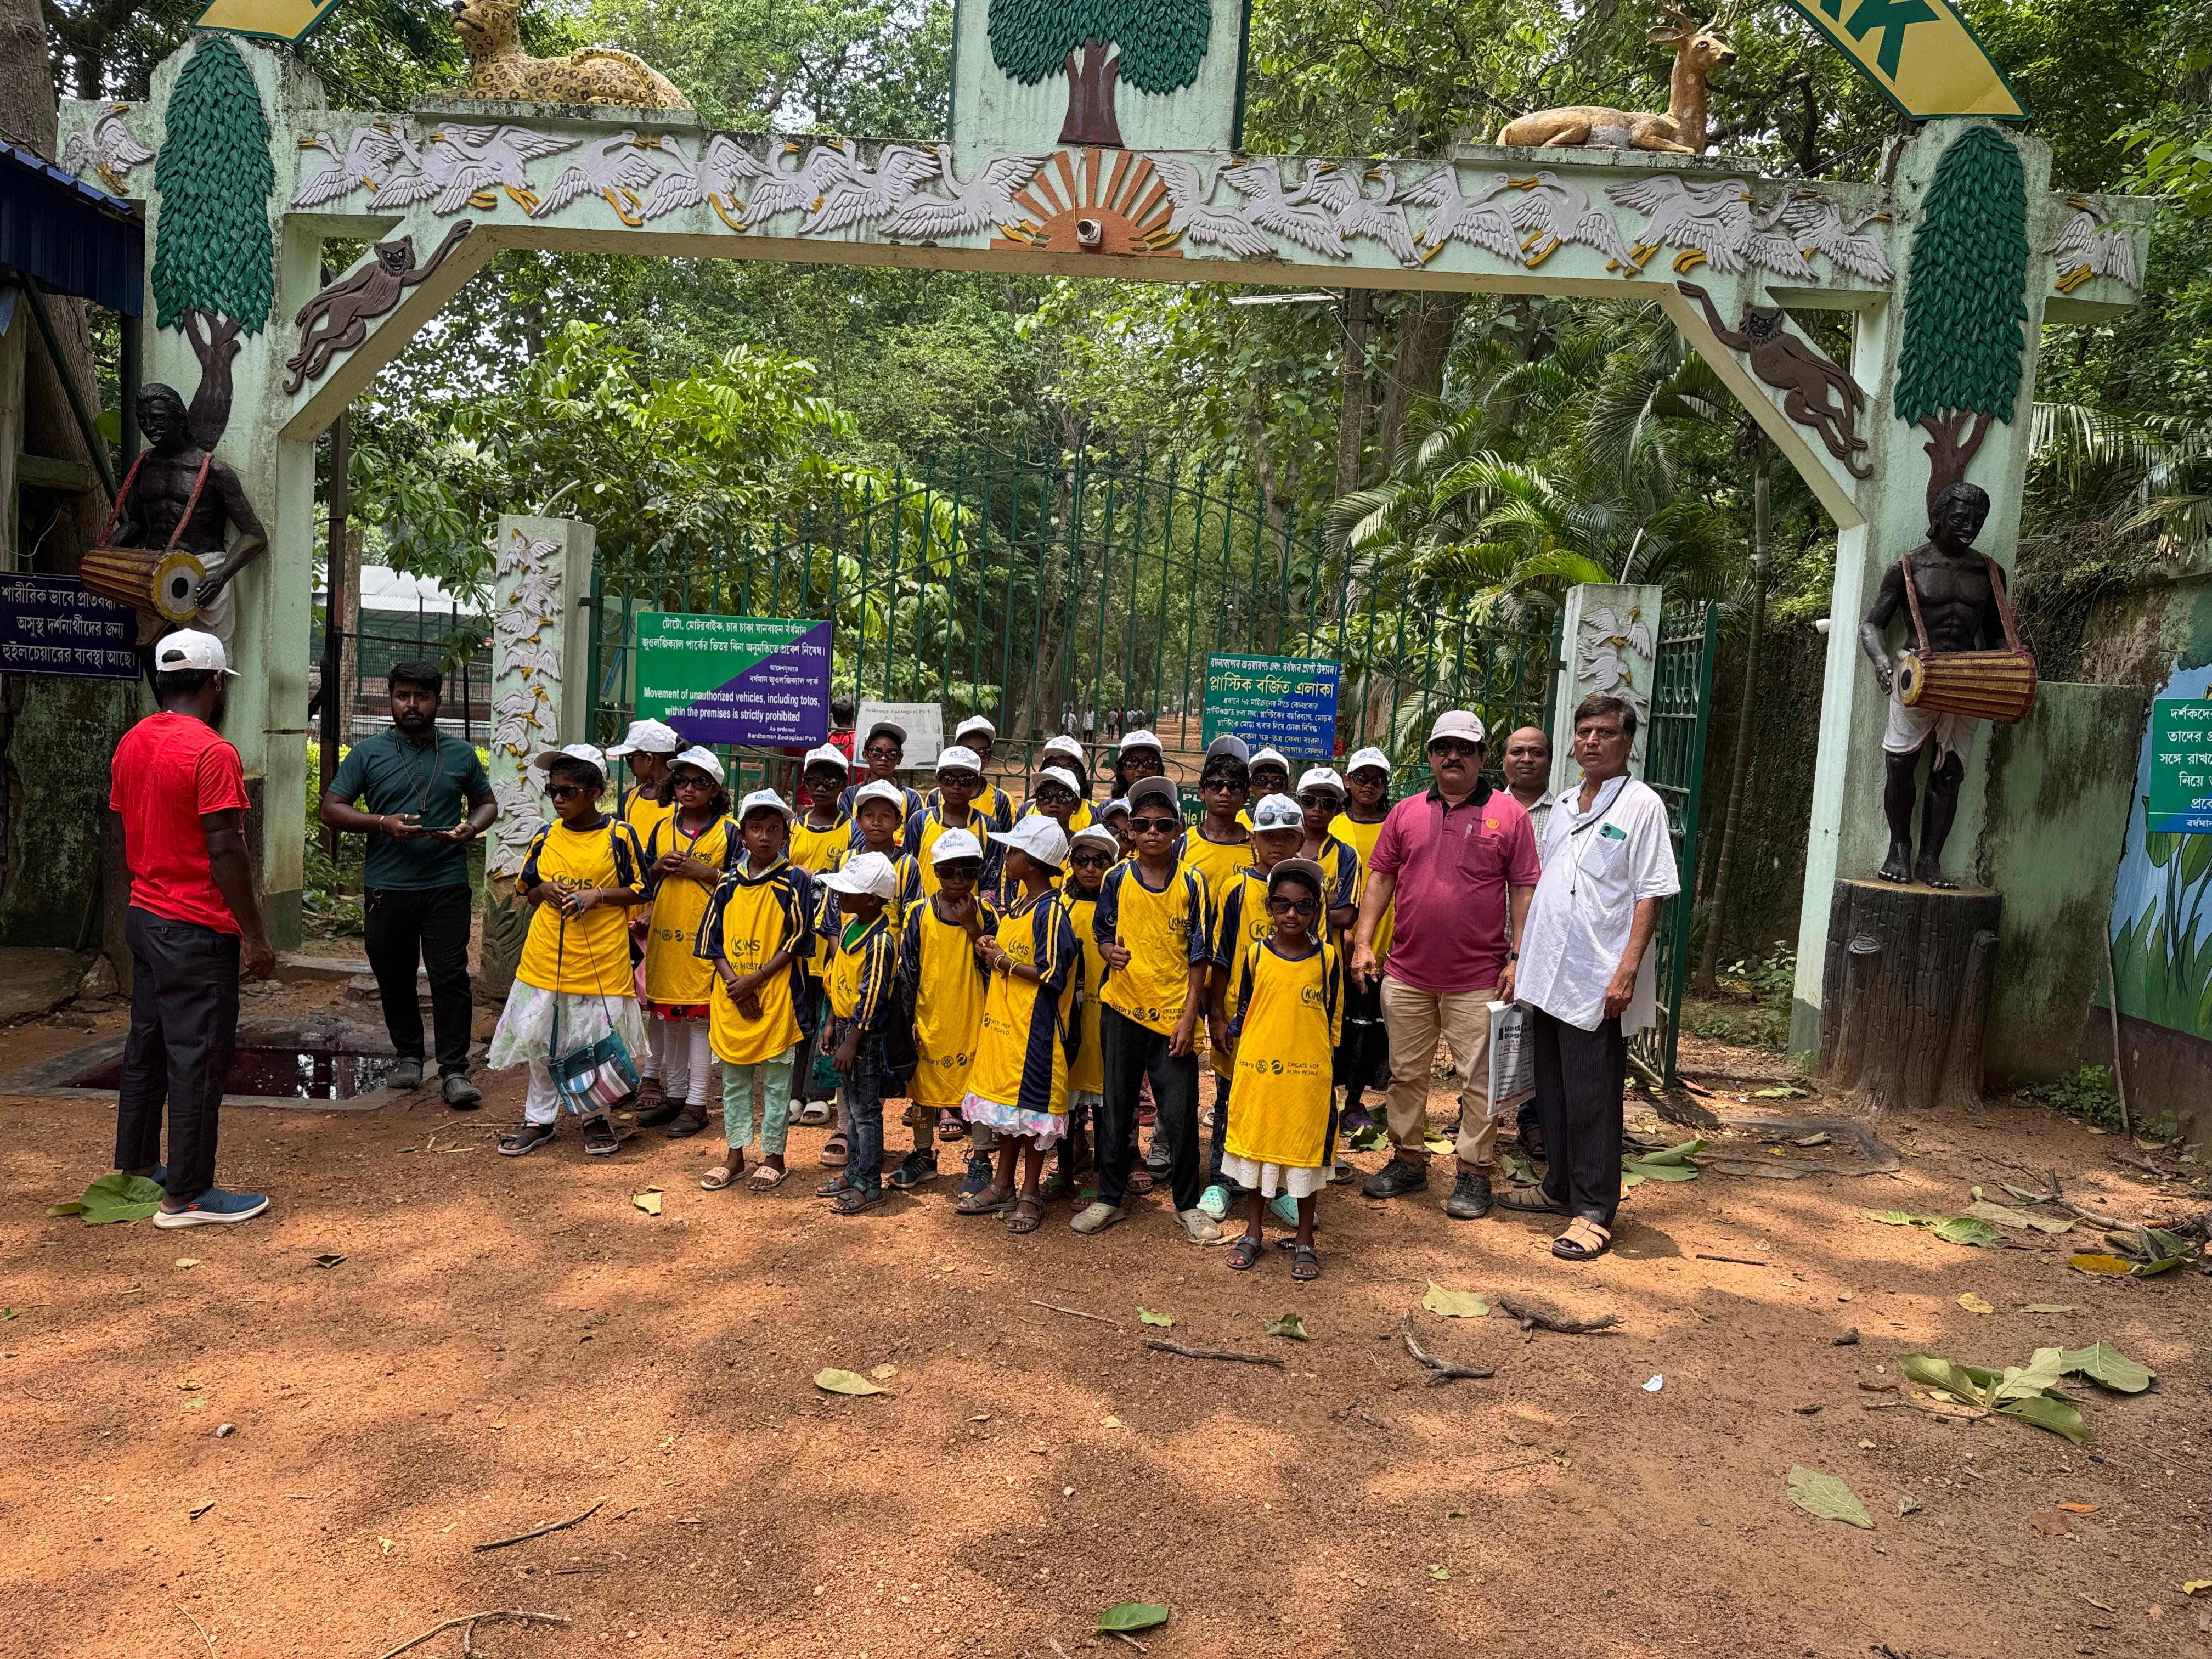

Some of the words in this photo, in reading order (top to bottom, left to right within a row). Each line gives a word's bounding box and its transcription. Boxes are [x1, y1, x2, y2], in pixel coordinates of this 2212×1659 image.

[2, 581, 47, 604] শারীরিক
[48, 589, 74, 607] ভাবে
[16, 616, 44, 638] অসুস্থ
[47, 613, 102, 636] দর্শনার্থীদের
[104, 622, 124, 639] জন্য
[662, 616, 684, 630] টোটো,
[686, 618, 725, 633] মোটরবাইক,
[726, 622, 737, 633] চার
[739, 622, 754, 633] চাকা
[755, 622, 783, 635] যানবাহন
[785, 622, 806, 636] বর্ধমান
[1, 639, 71, 663] হুইলচেয়ারের
[74, 647, 104, 669] ব্যবস্থা
[686, 637, 708, 651] পার্কের
[710, 637, 729, 652] ভিতর
[730, 639, 744, 652] বিনা
[746, 640, 779, 656] অনুমতিতে
[780, 643, 799, 655] প্রবেশ
[1269, 662, 1281, 672] এবং
[1283, 660, 1301, 673] বর্ধমান
[1302, 661, 1316, 674] প্রাণী
[749, 673, 768, 683] বর্ধমান
[806, 676, 819, 686] পার্ক
[1209, 672, 1253, 693] প্লাস্টিক
[1255, 674, 1291, 695] বর্জিত
[1294, 681, 1334, 699] এলাকা
[644, 686, 679, 699] Movement
[681, 689, 688, 699] of
[690, 690, 734, 702] unauthorized
[735, 691, 765, 706] vehicles,
[767, 692, 799, 708] including
[800, 695, 820, 708] totos,
[665, 705, 686, 716] within
[687, 706, 698, 717] the
[699, 707, 731, 720] premises
[732, 708, 739, 719] is
[741, 709, 764, 723] strictly
[765, 710, 800, 723] prohibited
[2170, 703, 2212, 720] দর্শকদে
[1272, 720, 1284, 730] নিয়ে
[777, 733, 804, 742] Zoological
[2166, 730, 2203, 743] তাদের
[2158, 753, 2183, 765] সঙ্গে
[2178, 771, 2204, 787] নিয়ে
